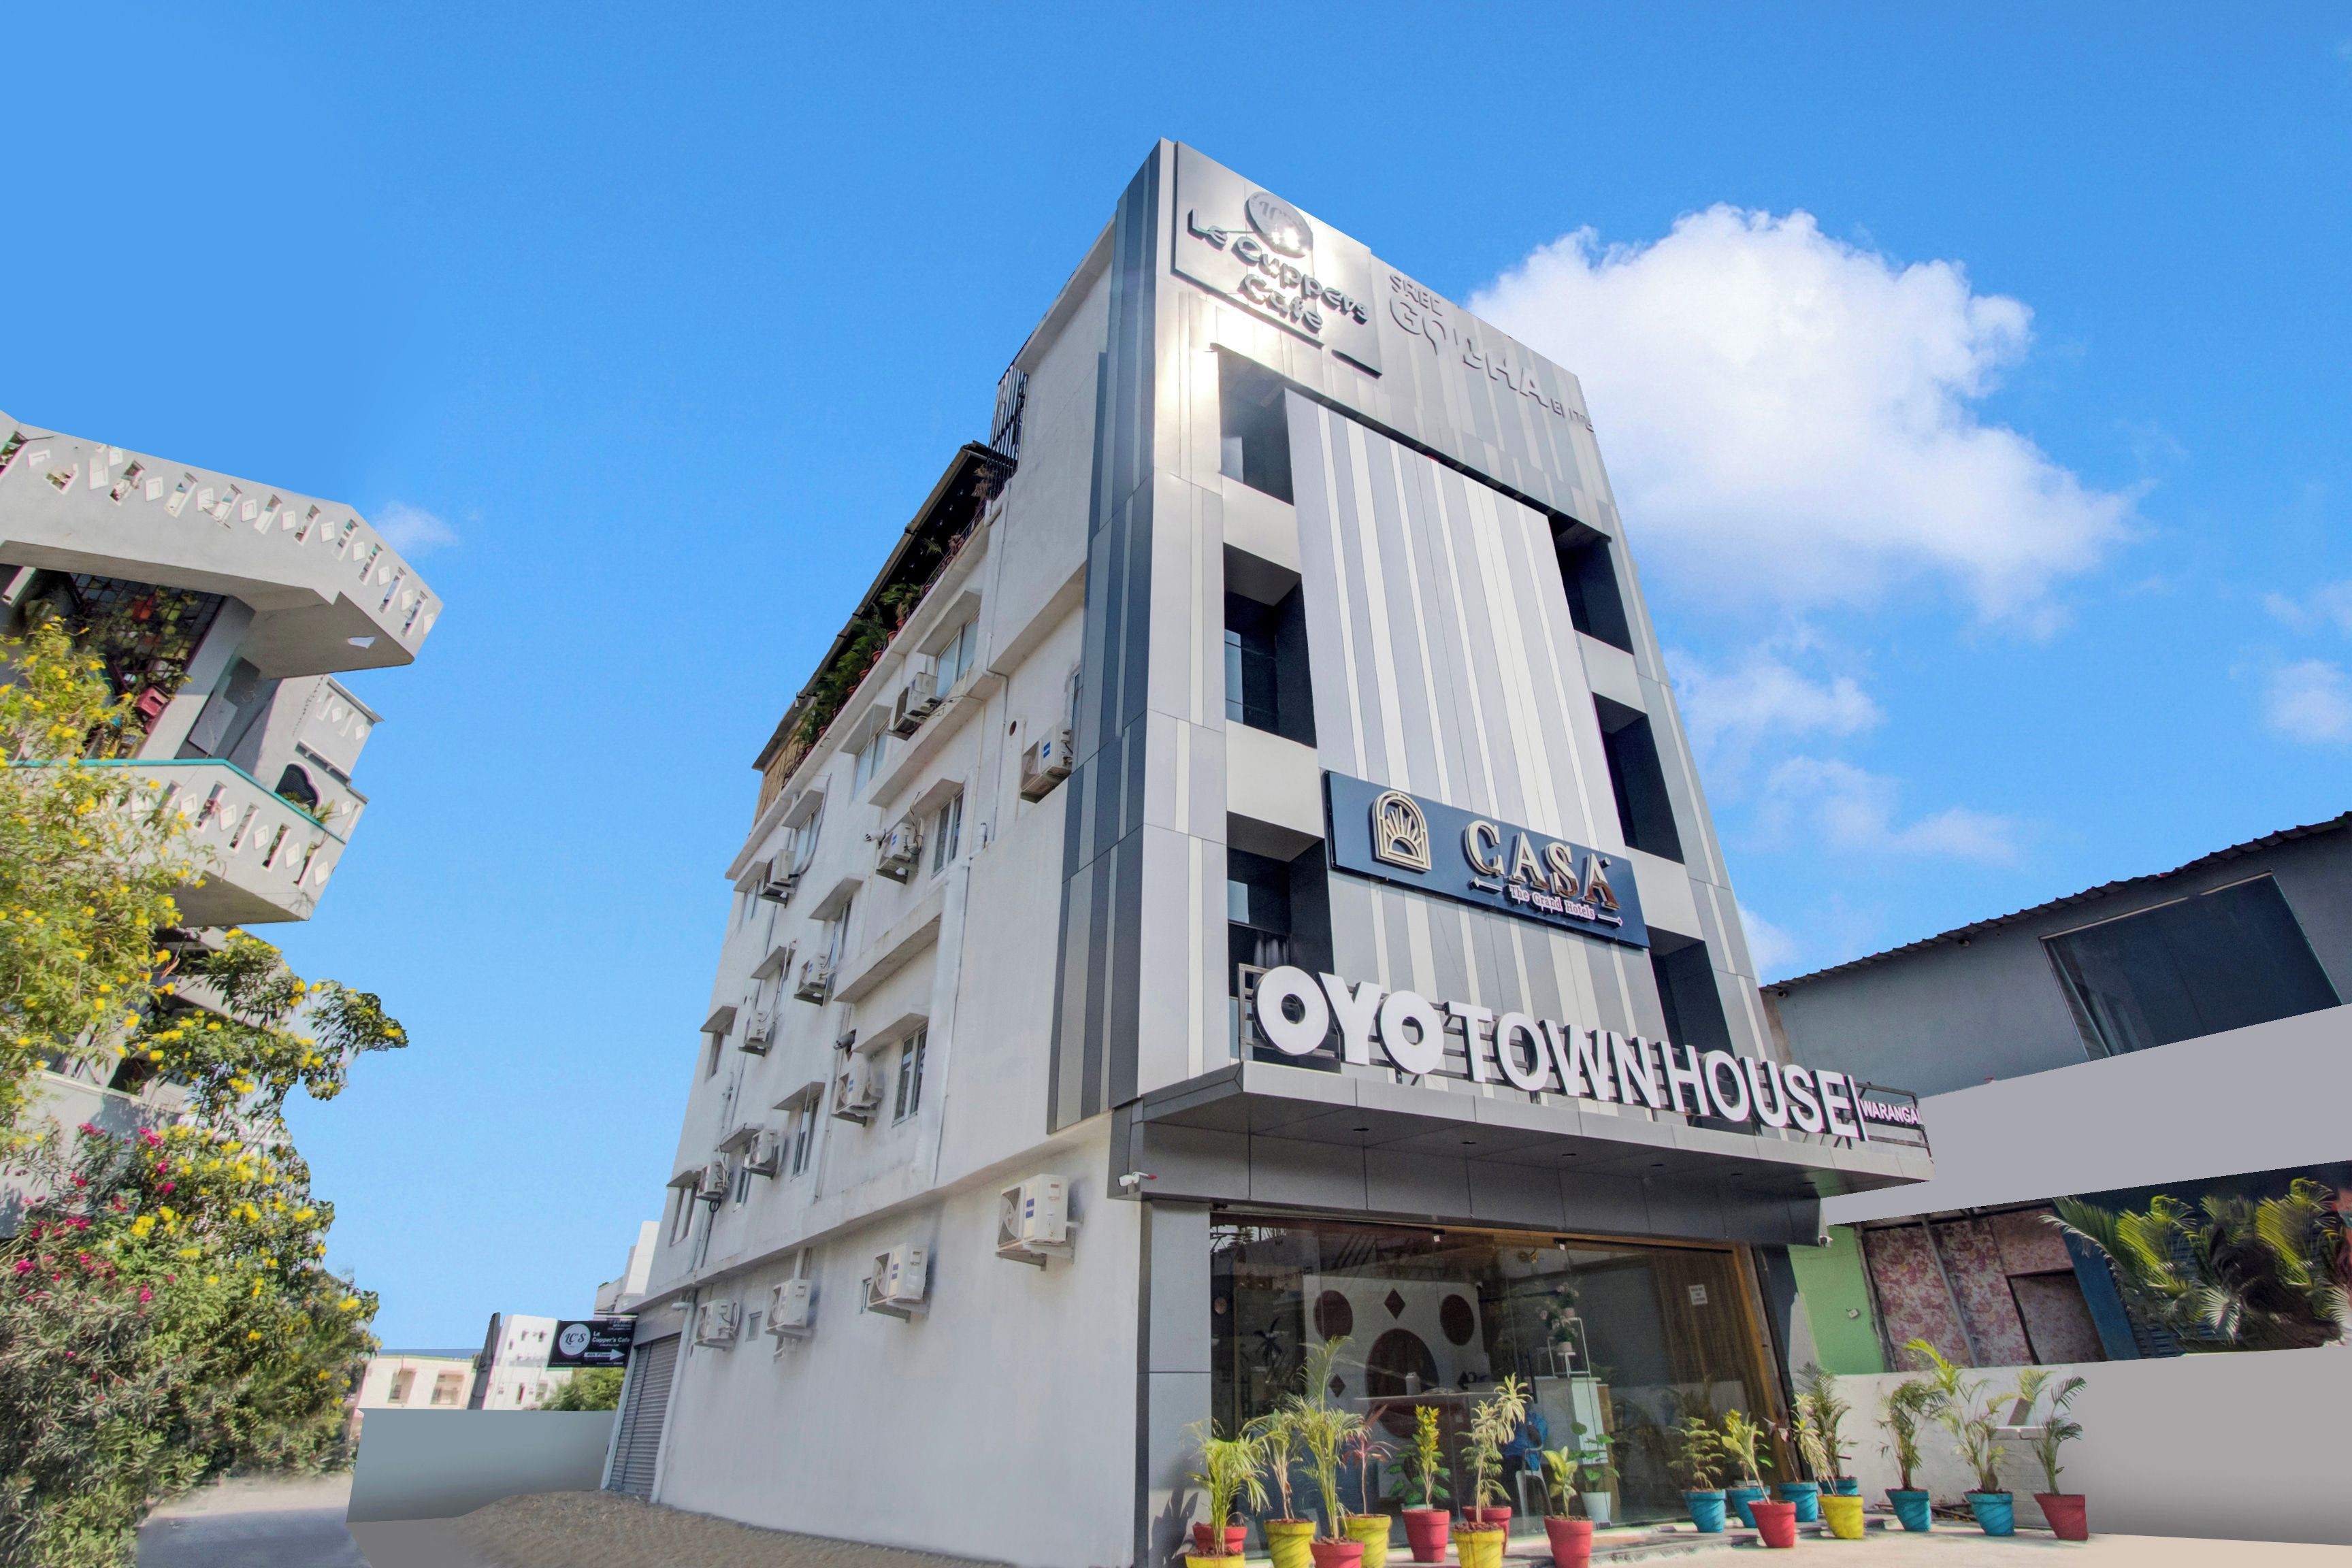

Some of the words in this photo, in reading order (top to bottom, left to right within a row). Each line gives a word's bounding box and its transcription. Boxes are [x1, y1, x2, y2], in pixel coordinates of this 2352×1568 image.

[1188, 208, 1228, 251] Le
[1237, 273, 1324, 333] Cafe
[1463, 819, 1621, 911] CASA
[1509, 884, 1531, 902] The
[1532, 892, 1563, 912] Grand
[1564, 899, 1595, 920] Hotels
[1253, 965, 1444, 1075] OYO
